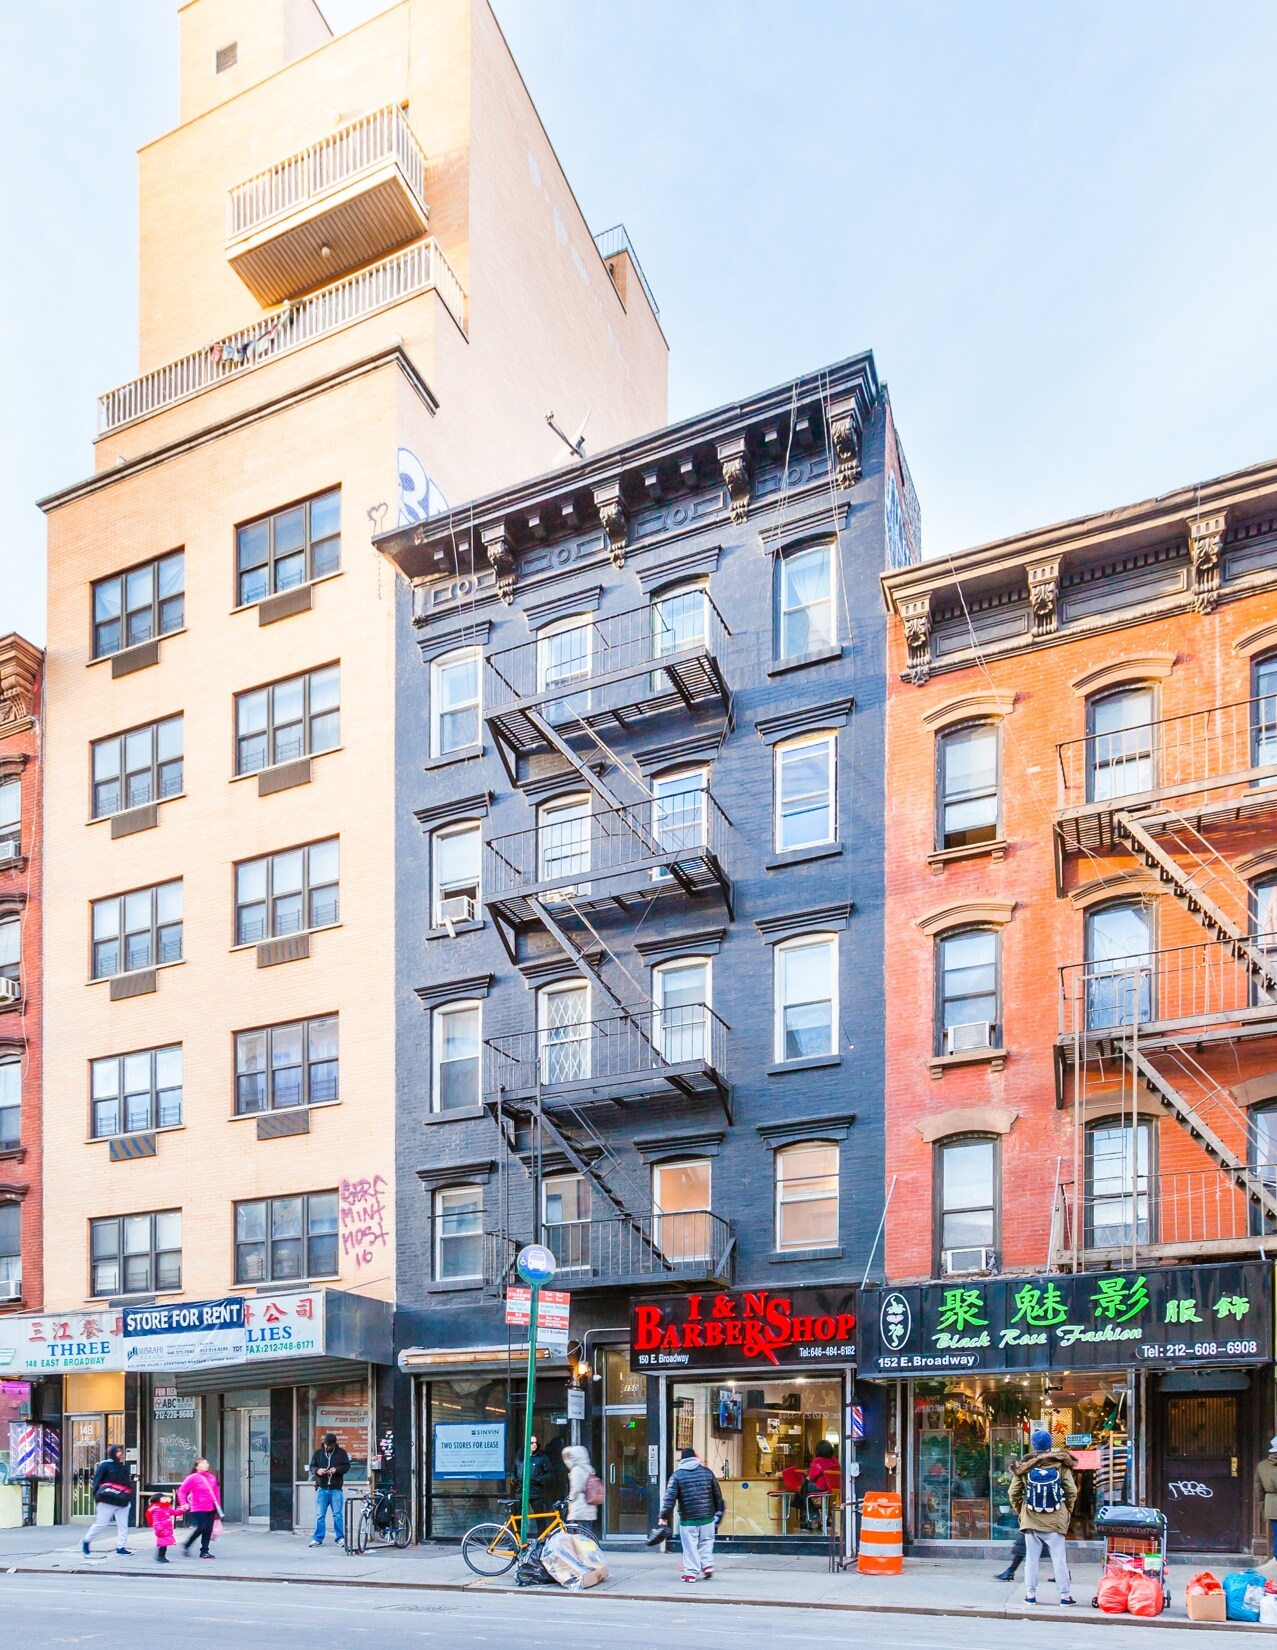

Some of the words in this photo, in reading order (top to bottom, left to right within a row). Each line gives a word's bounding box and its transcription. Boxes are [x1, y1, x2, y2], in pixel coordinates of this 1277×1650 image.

[688, 1295, 702, 1320] I
[712, 1293, 736, 1318] &
[742, 1291, 768, 1317] N
[127, 1311, 169, 1331] STORE
[172, 1309, 199, 1328] FOR
[203, 1304, 240, 1324] RENT
[246, 1325, 293, 1343] LIES
[931, 1331, 991, 1349] Black
[998, 1328, 1047, 1349] Rose
[1056, 1324, 1143, 1347] Fashion
[47, 1341, 111, 1357] THREE
[25, 1360, 38, 1368] 148
[41, 1359, 60, 1368] EAST
[63, 1356, 106, 1366] BROADWAY
[639, 1355, 649, 1364] 150
[658, 1353, 689, 1364] Broadway
[878, 1357, 898, 1368] 152
[913, 1354, 976, 1367] Broadway
[162, 1399, 177, 1408] ABC
[453, 1441, 472, 1449] STORES
[473, 1441, 483, 1449] FOR
[484, 1441, 499, 1449] LEASE
